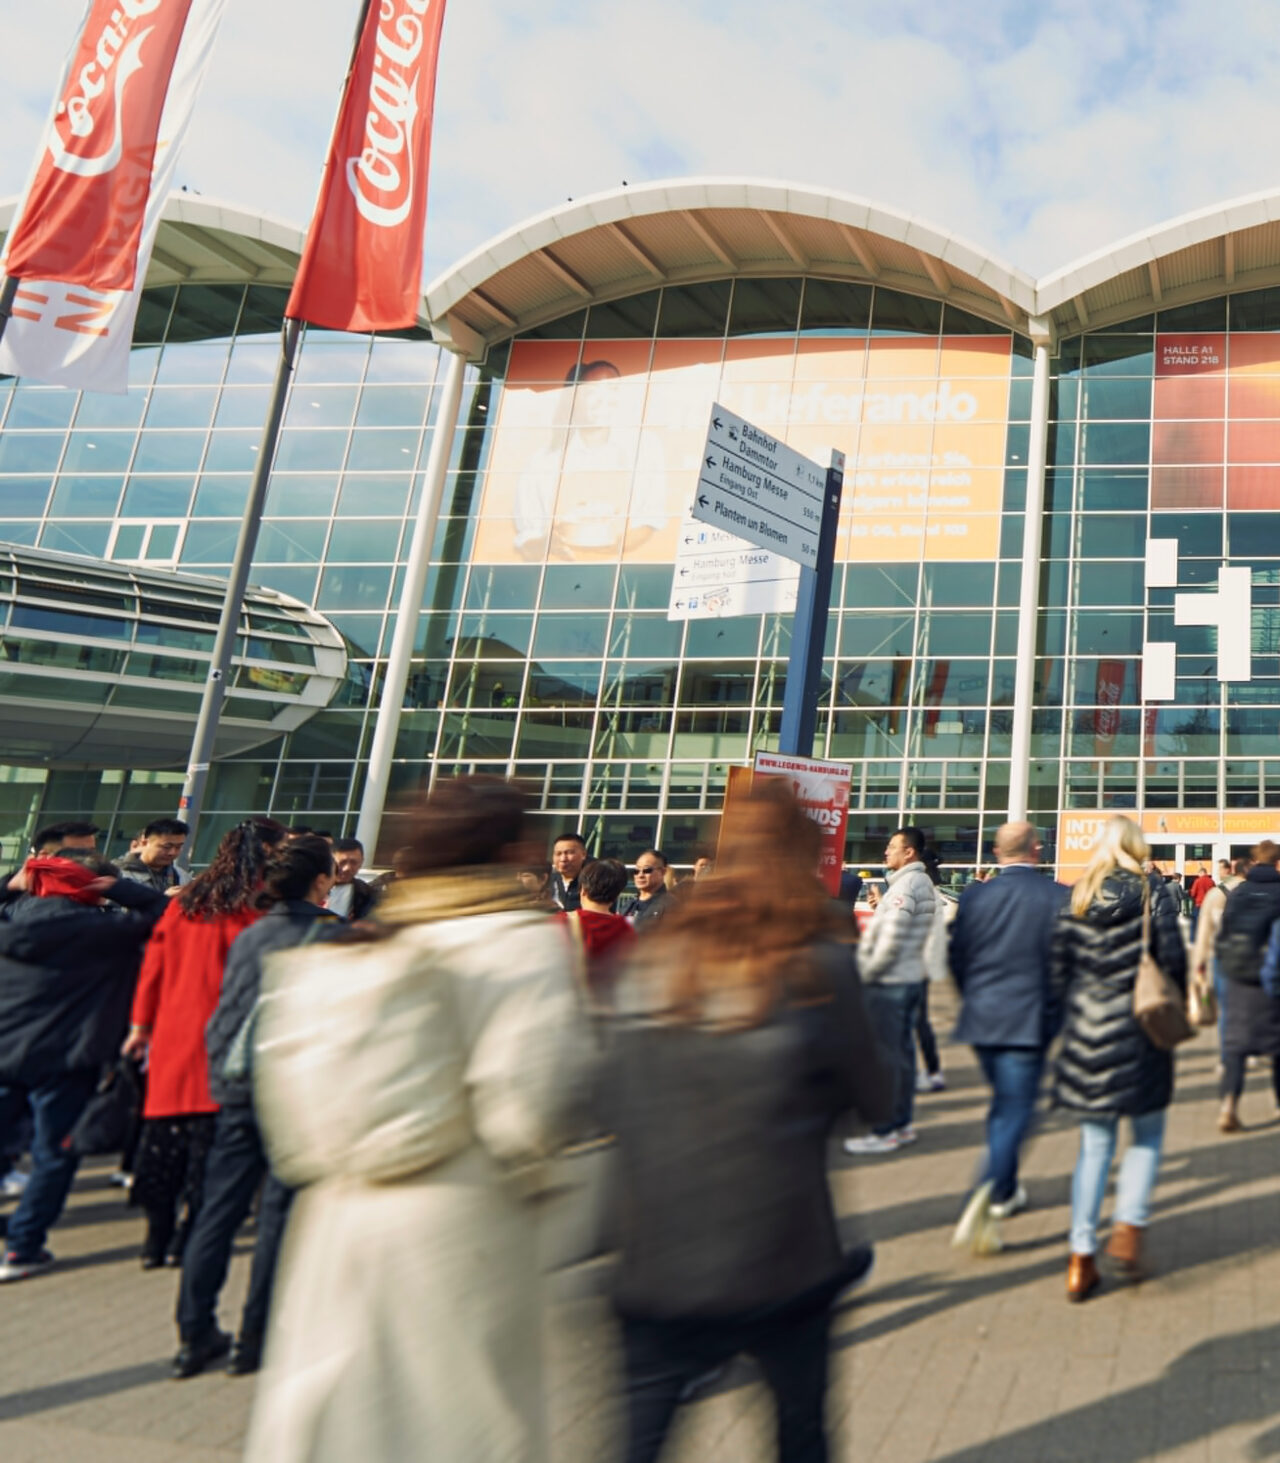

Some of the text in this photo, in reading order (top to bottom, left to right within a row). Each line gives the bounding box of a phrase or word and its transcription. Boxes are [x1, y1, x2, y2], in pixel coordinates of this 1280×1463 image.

[1163, 346, 1199, 354] HALLE
[1163, 356, 1199, 365] STAND
[741, 424, 778, 453] Bahnhof
[739, 440, 778, 470] Dammtor
[719, 472, 758, 500] Eingang Ost
[722, 456, 789, 501] Hamburg Messe
[714, 500, 788, 545] Planten un Blomen
[693, 554, 769, 569] Hamburg Messe
[1176, 815, 1273, 830] Willkommen!
